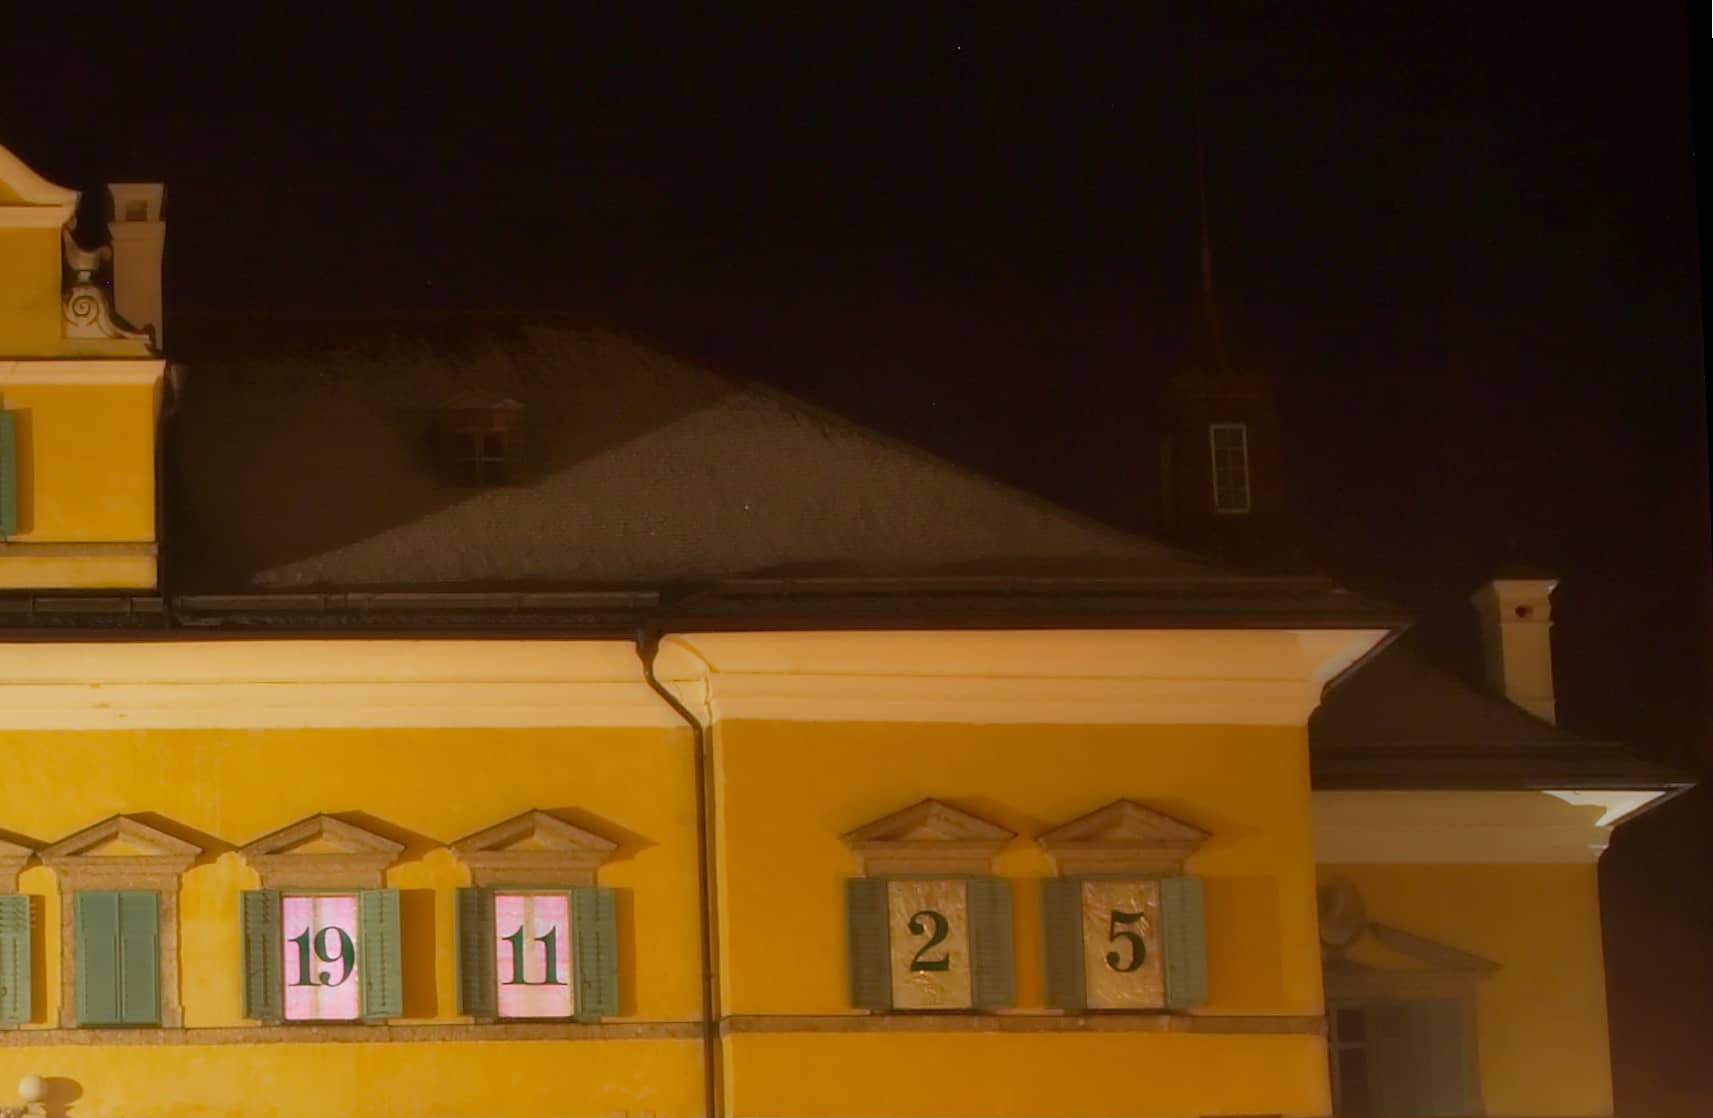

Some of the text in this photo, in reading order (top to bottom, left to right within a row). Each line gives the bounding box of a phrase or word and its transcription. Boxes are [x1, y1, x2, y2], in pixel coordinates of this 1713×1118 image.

[289, 925, 355, 987] 19
[502, 924, 568, 986] 11
[908, 910, 950, 972] 2
[1106, 910, 1147, 973] 5
